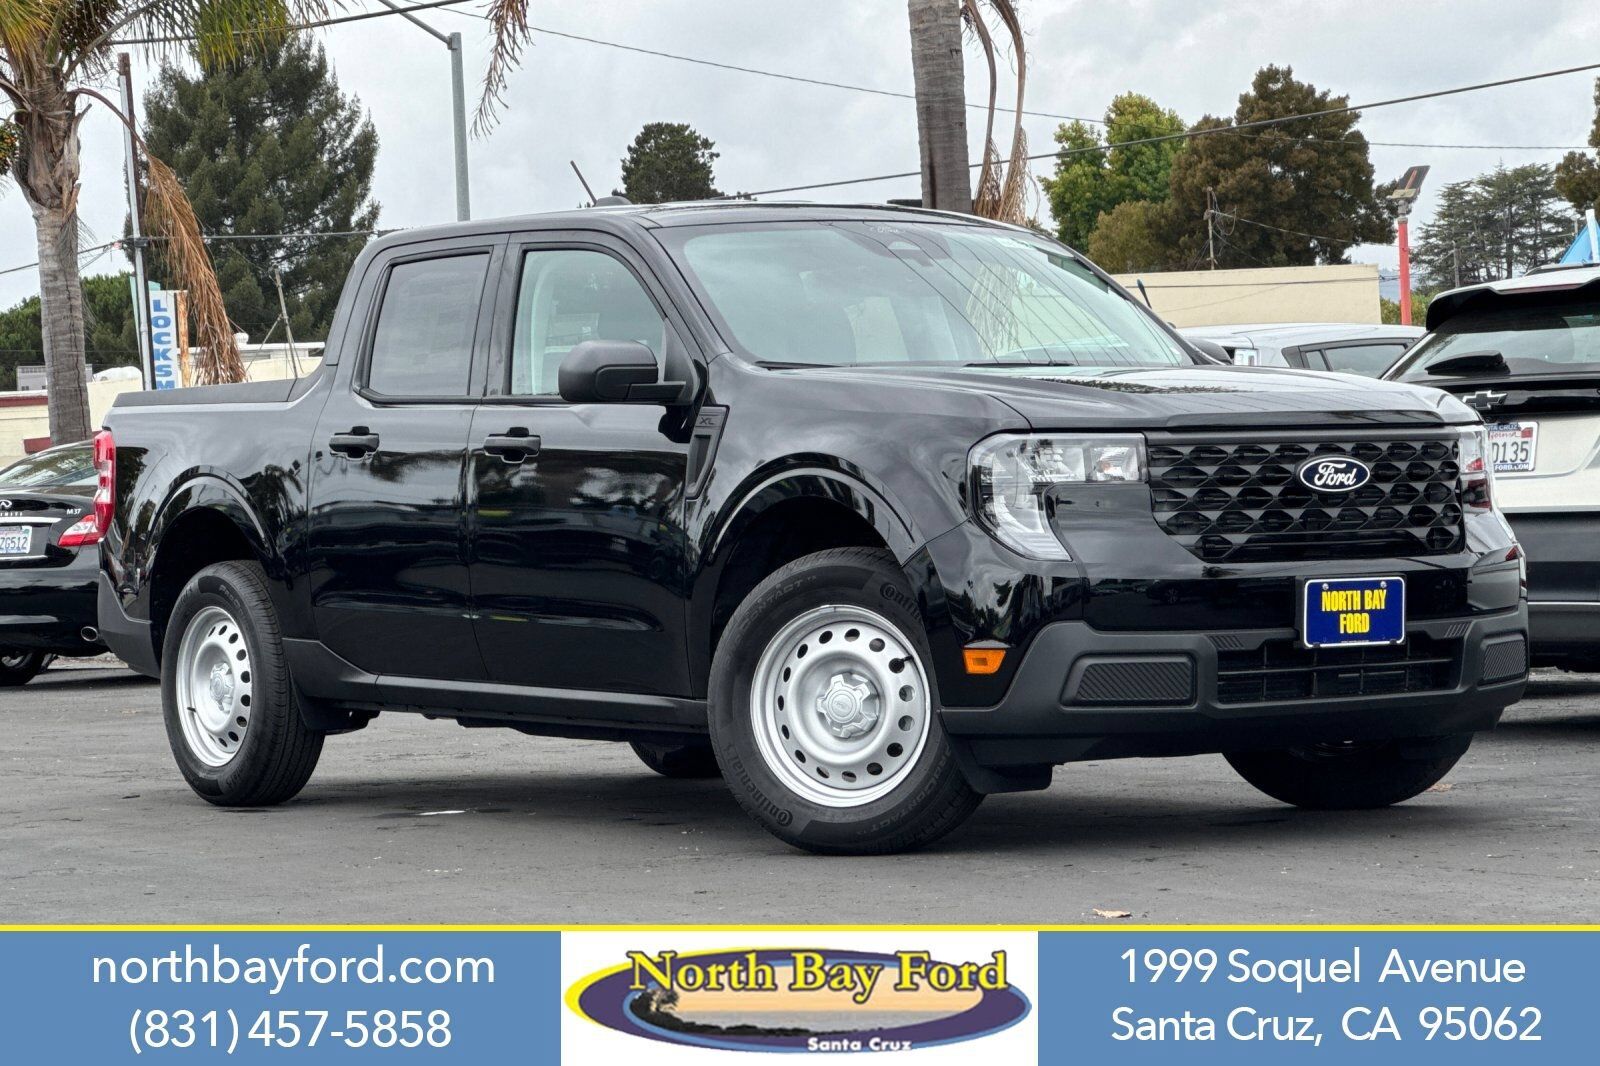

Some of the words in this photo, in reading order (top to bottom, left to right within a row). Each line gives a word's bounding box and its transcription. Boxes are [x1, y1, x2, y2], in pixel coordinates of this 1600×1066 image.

[700, 417, 715, 425] XL
[1314, 462, 1357, 486] Ford
[1321, 590, 1361, 612] NORTH
[1364, 589, 1387, 609] BAY
[1339, 613, 1370, 633] FORD
